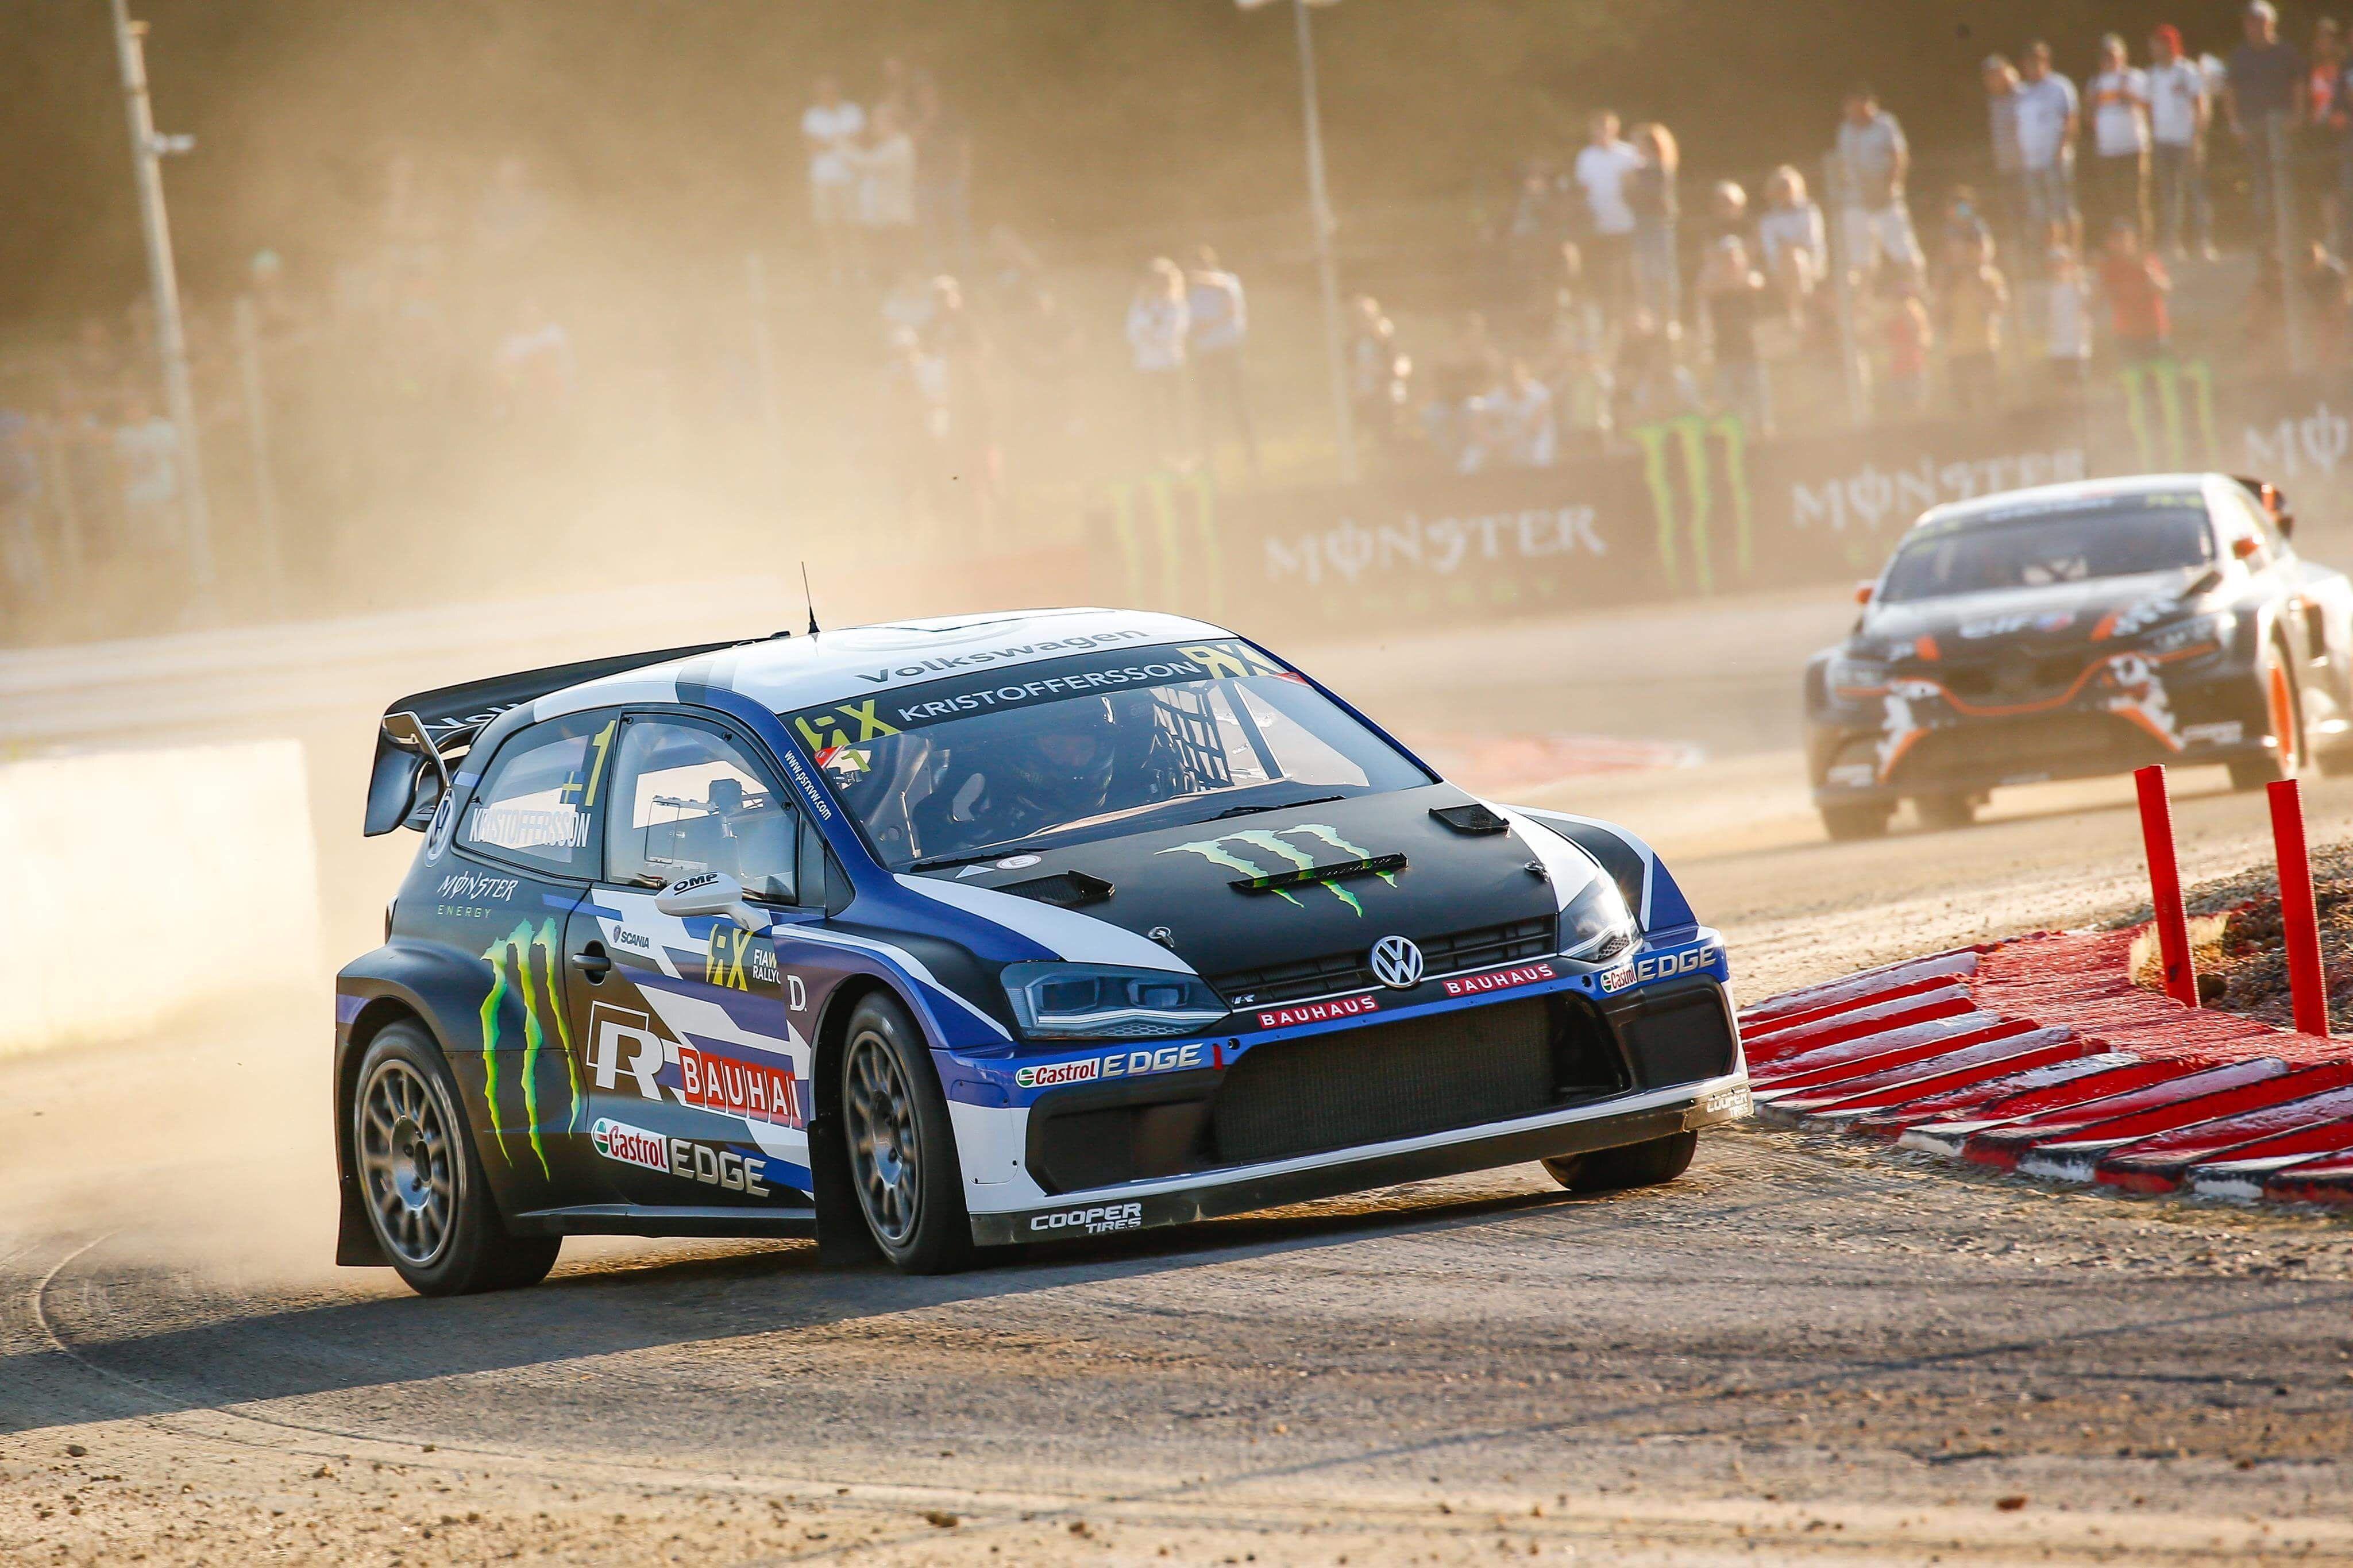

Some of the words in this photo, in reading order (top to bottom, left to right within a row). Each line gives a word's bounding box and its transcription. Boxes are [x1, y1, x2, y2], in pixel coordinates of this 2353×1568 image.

[854, 629, 1151, 683] Volkswagen
[898, 661, 1202, 722] KRISTOFFERSSON
[585, 720, 617, 807] 1
[784, 750, 832, 821] www.psrxvw.com
[469, 808, 592, 848] KRISTOFFERSSON
[673, 873, 719, 892] OMP
[437, 905, 492, 919] ENERGY
[620, 931, 650, 949] SCANIA
[1445, 965, 1553, 995] BAUHAUS
[1610, 965, 1637, 989] Castrol
[1637, 945, 1717, 982] EDGE
[1260, 996, 1376, 1027] BAUHAUS
[586, 1000, 664, 1102] R
[1035, 1061, 1097, 1085] Castrol
[1101, 1042, 1204, 1078] EDGE
[608, 1125, 667, 1169] Castrol
[671, 1138, 770, 1198] EDGE
[1030, 1202, 1142, 1231] COOPER
[1085, 1216, 1142, 1234] TIRES
